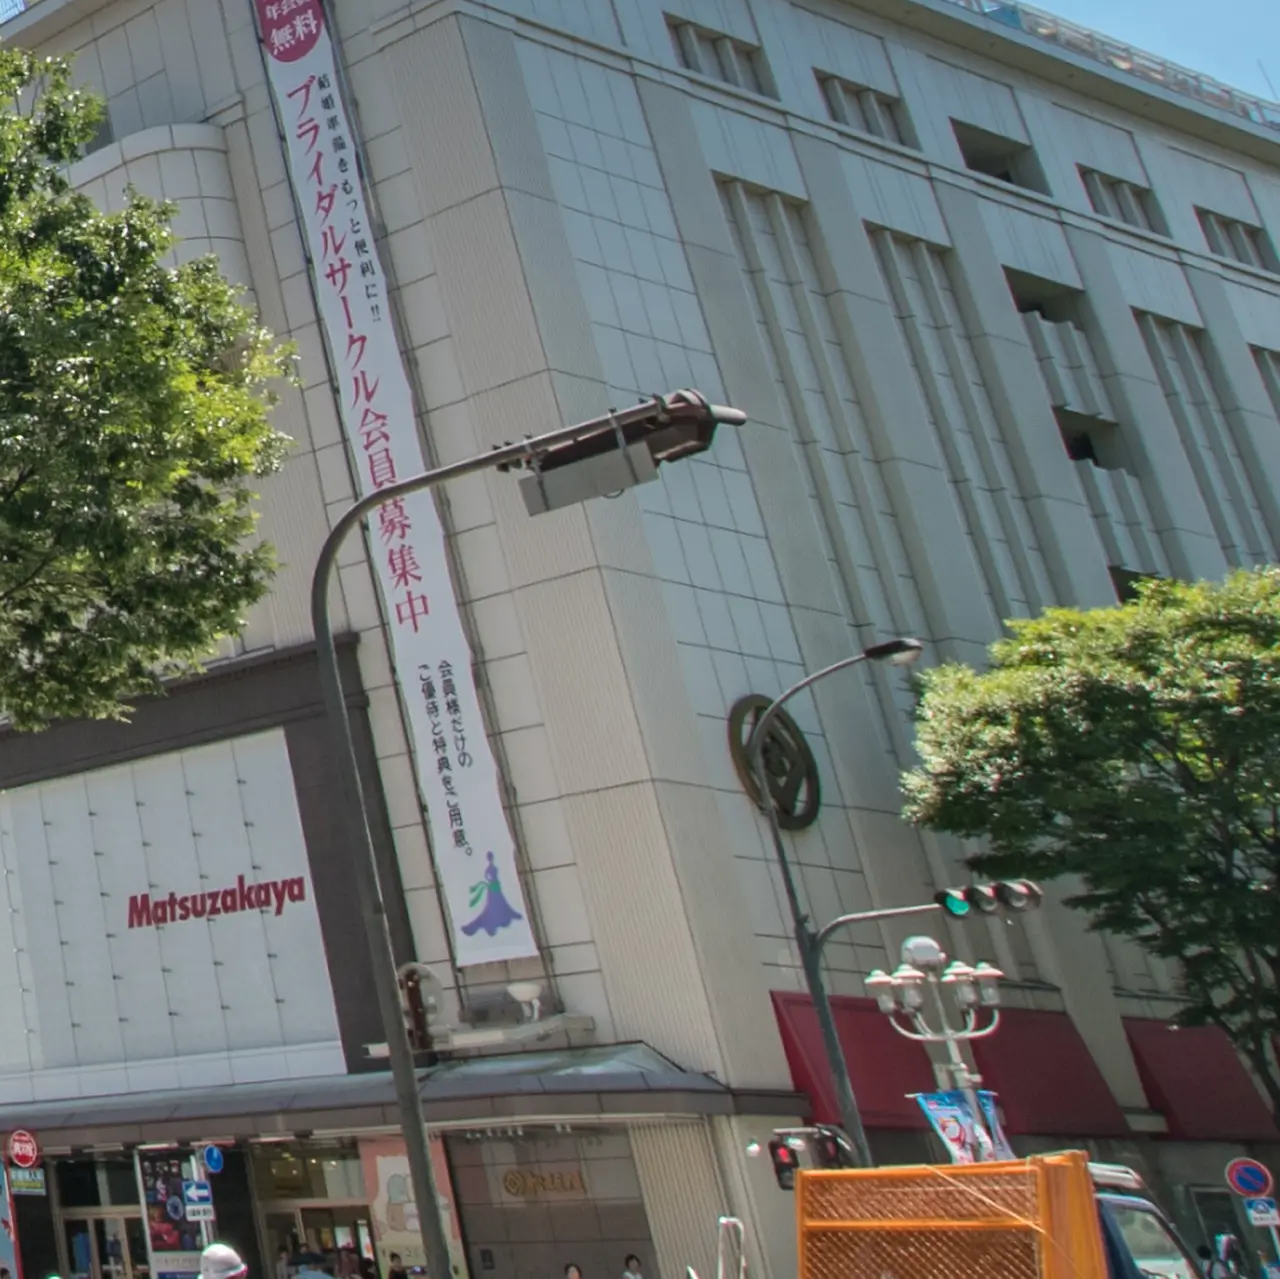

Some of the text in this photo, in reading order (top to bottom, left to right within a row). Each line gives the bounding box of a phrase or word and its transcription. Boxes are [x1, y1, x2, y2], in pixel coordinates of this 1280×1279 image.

[270, 9, 318, 55] 無料
[286, 74, 430, 634] ブライダルサークル会員募集中
[437, 659, 474, 768] 会員様だけの
[127, 873, 306, 929] Matsuzakaya
